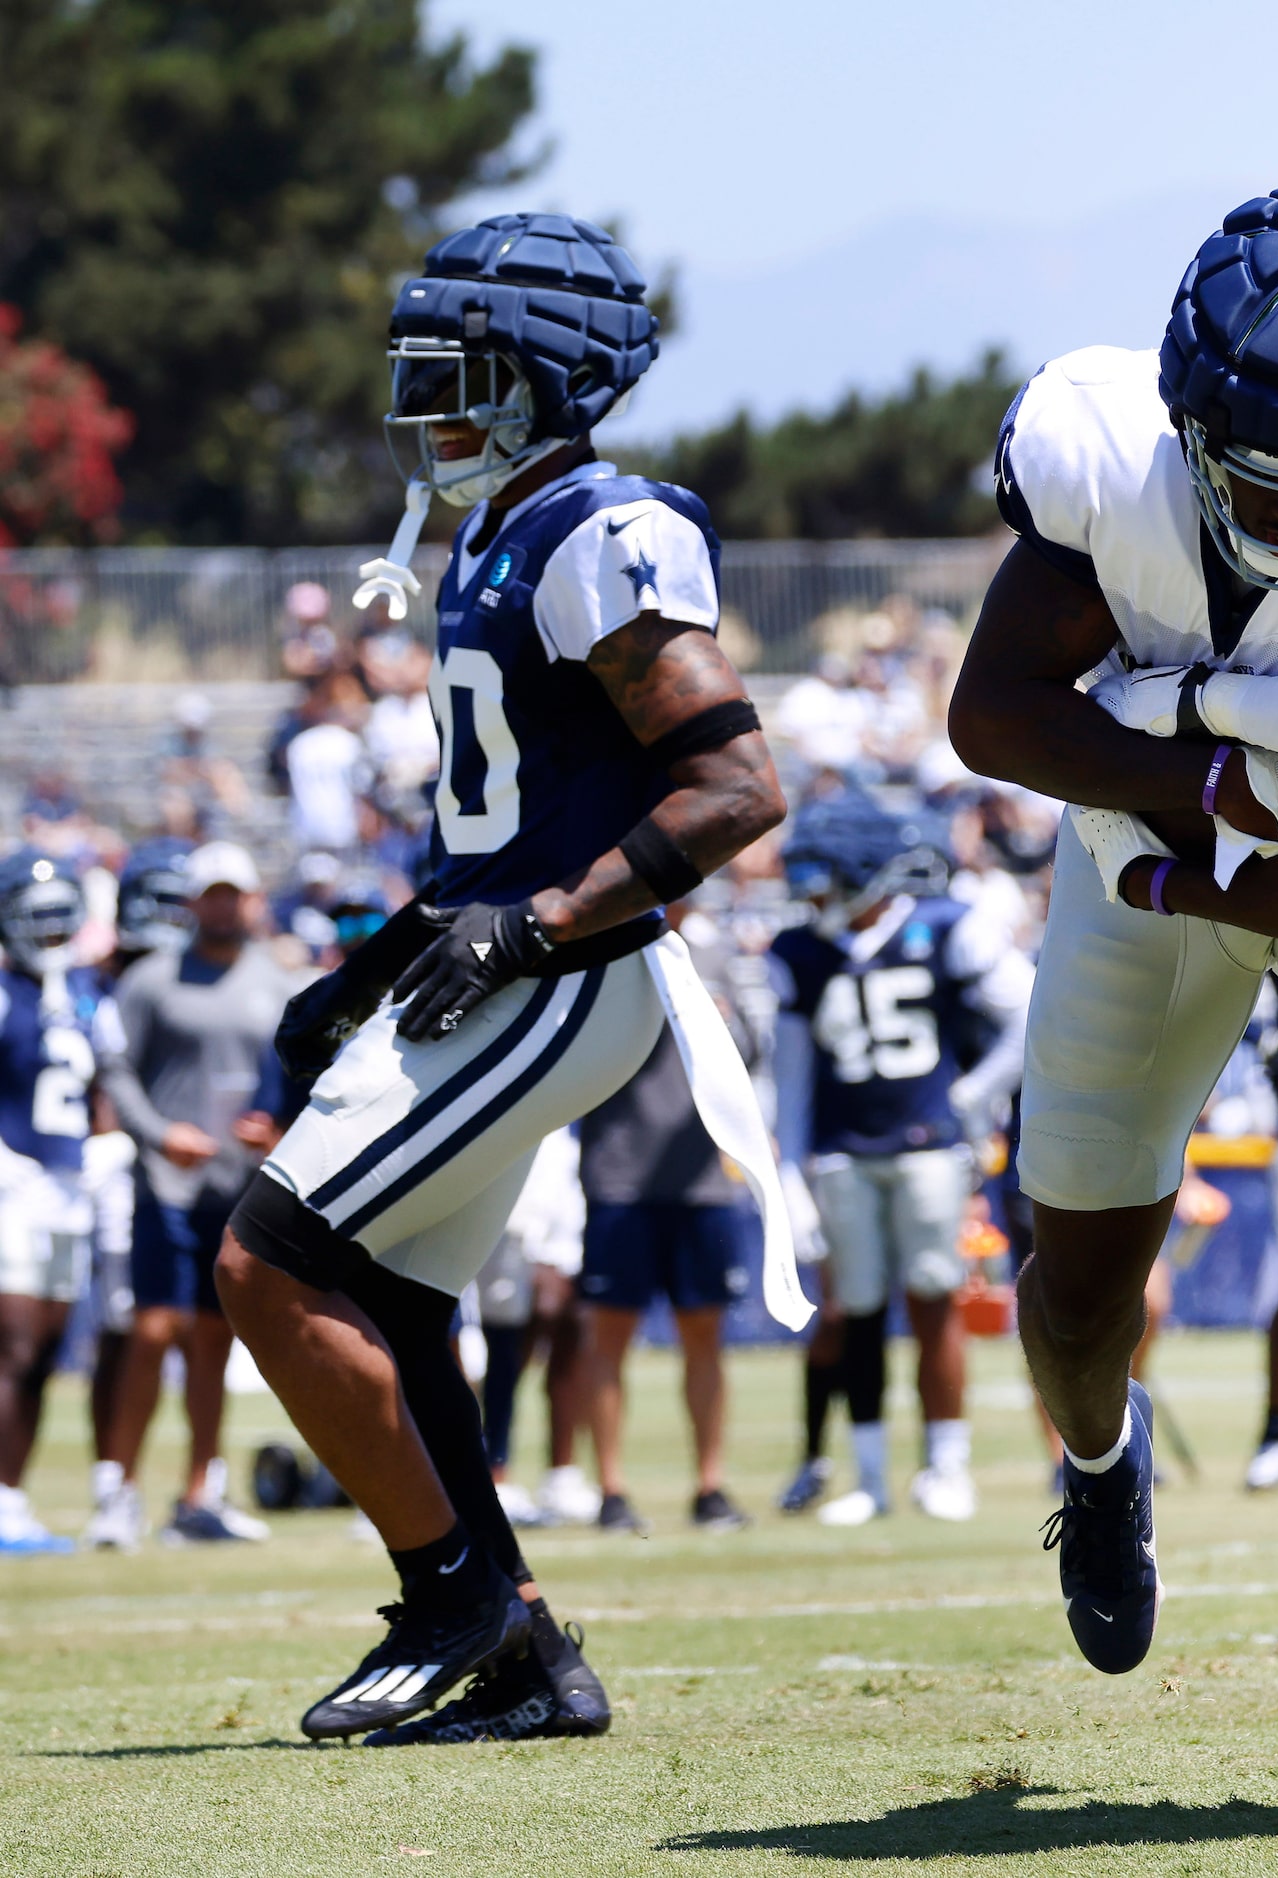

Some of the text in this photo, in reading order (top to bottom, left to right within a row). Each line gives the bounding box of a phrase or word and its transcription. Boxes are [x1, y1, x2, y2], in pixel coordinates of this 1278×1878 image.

[1206, 768, 1219, 787] FAITH
[812, 966, 940, 1083] 45
[32, 1026, 96, 1139] 2
